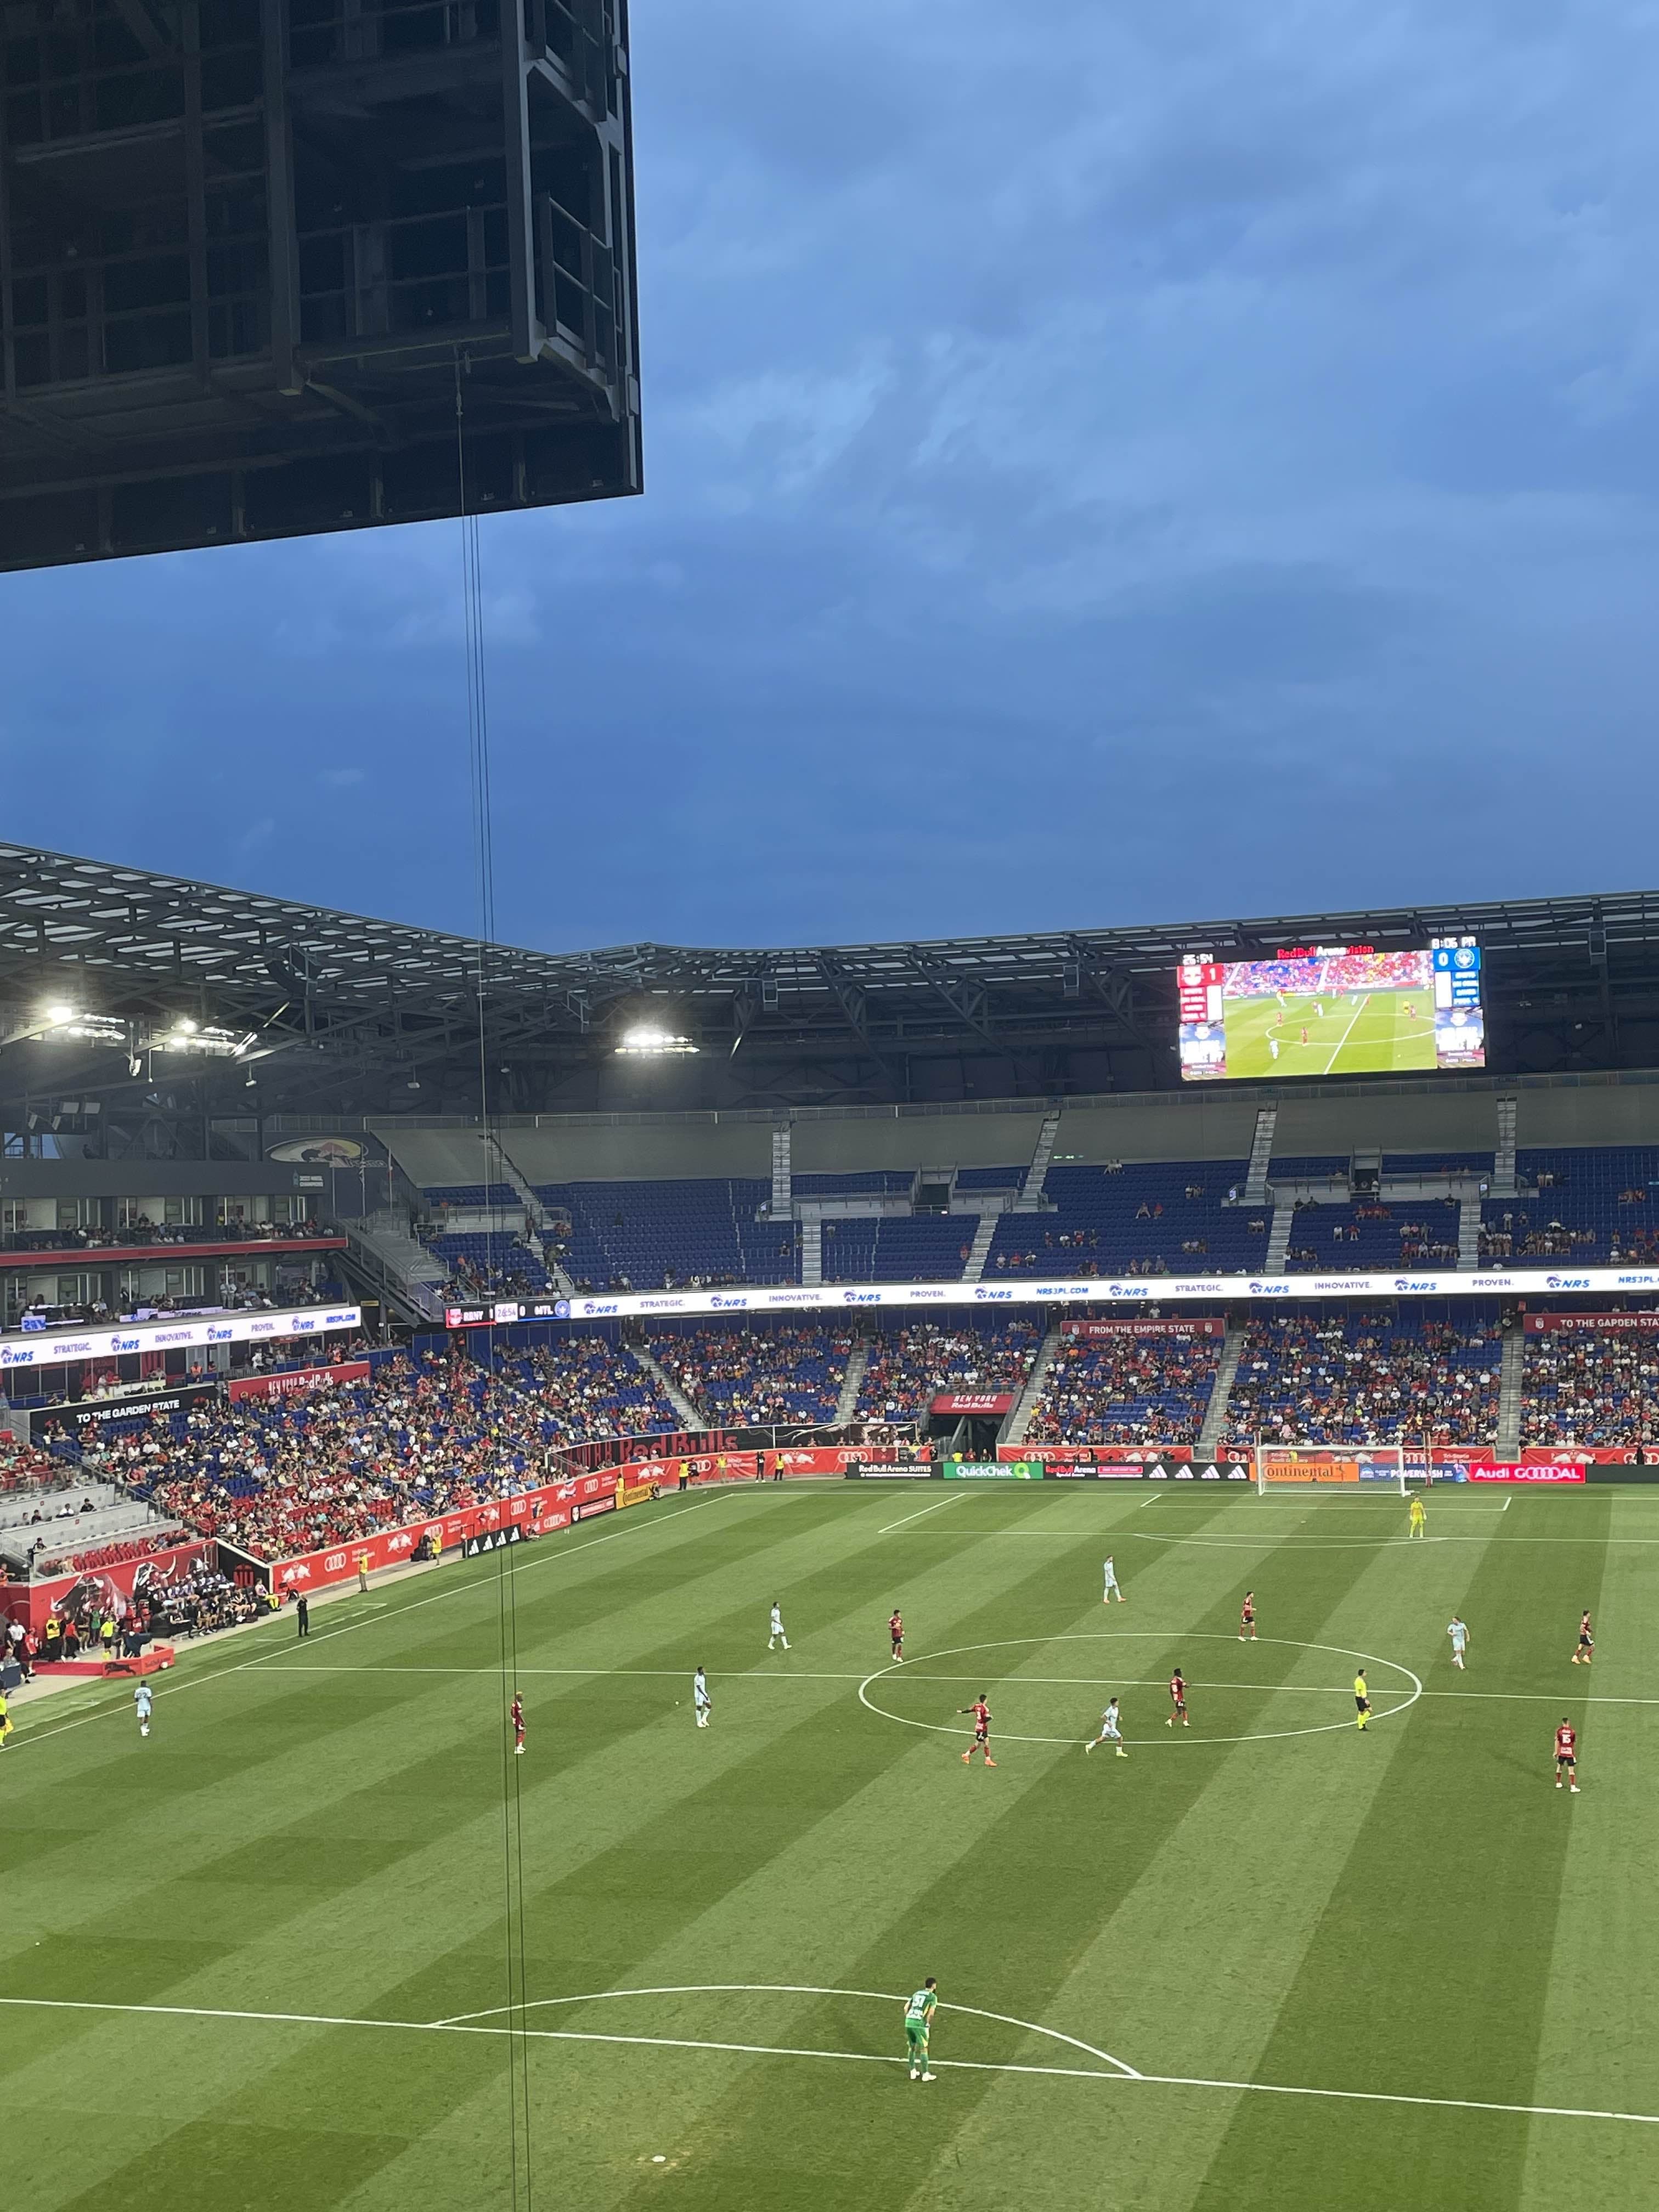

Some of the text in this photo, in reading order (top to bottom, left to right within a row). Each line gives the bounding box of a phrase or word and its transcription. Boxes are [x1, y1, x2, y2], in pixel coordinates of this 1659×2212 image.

[1438, 952, 1448, 967] 0
[1209, 967, 1216, 981] 1
[1314, 1282, 1373, 1290] INNOVATIVE.
[1409, 1283, 1437, 1291] NRS
[1562, 1279, 1590, 1288] NRS
[1036, 1287, 1088, 1295] NRS3PL.COM
[1123, 1288, 1148, 1296] NRS
[1263, 1285, 1289, 1294] NRS
[769, 1294, 822, 1302] INNOVATIVE.
[856, 1294, 882, 1302] NRS
[988, 1291, 1013, 1299] NRS
[639, 1300, 685, 1308] STRATEGIC.
[724, 1299, 747, 1307] NRS
[520, 1306, 553, 1316] 0 MTL
[595, 1305, 618, 1314] NRS
[299, 1321, 315, 1330] NRS
[1560, 1318, 1659, 1328] TO THE GARDEN STA
[1090, 1324, 1195, 1334] FROM THE EMPIRE STATE
[217, 1330, 233, 1340] NRS
[54, 1342, 92, 1355] STRATEGIC.
[120, 1339, 140, 1351] NRS
[12, 1351, 34, 1363] NRS
[76, 1400, 180, 1424] TO THE GARDEN STATE
[671, 1430, 738, 1455] Bulls
[859, 1464, 873, 1472] Red
[873, 1464, 887, 1472] Bull
[956, 1465, 1013, 1477] QuickChek
[1263, 1465, 1334, 1480] Continental
[1475, 1468, 1509, 1479] Audi
